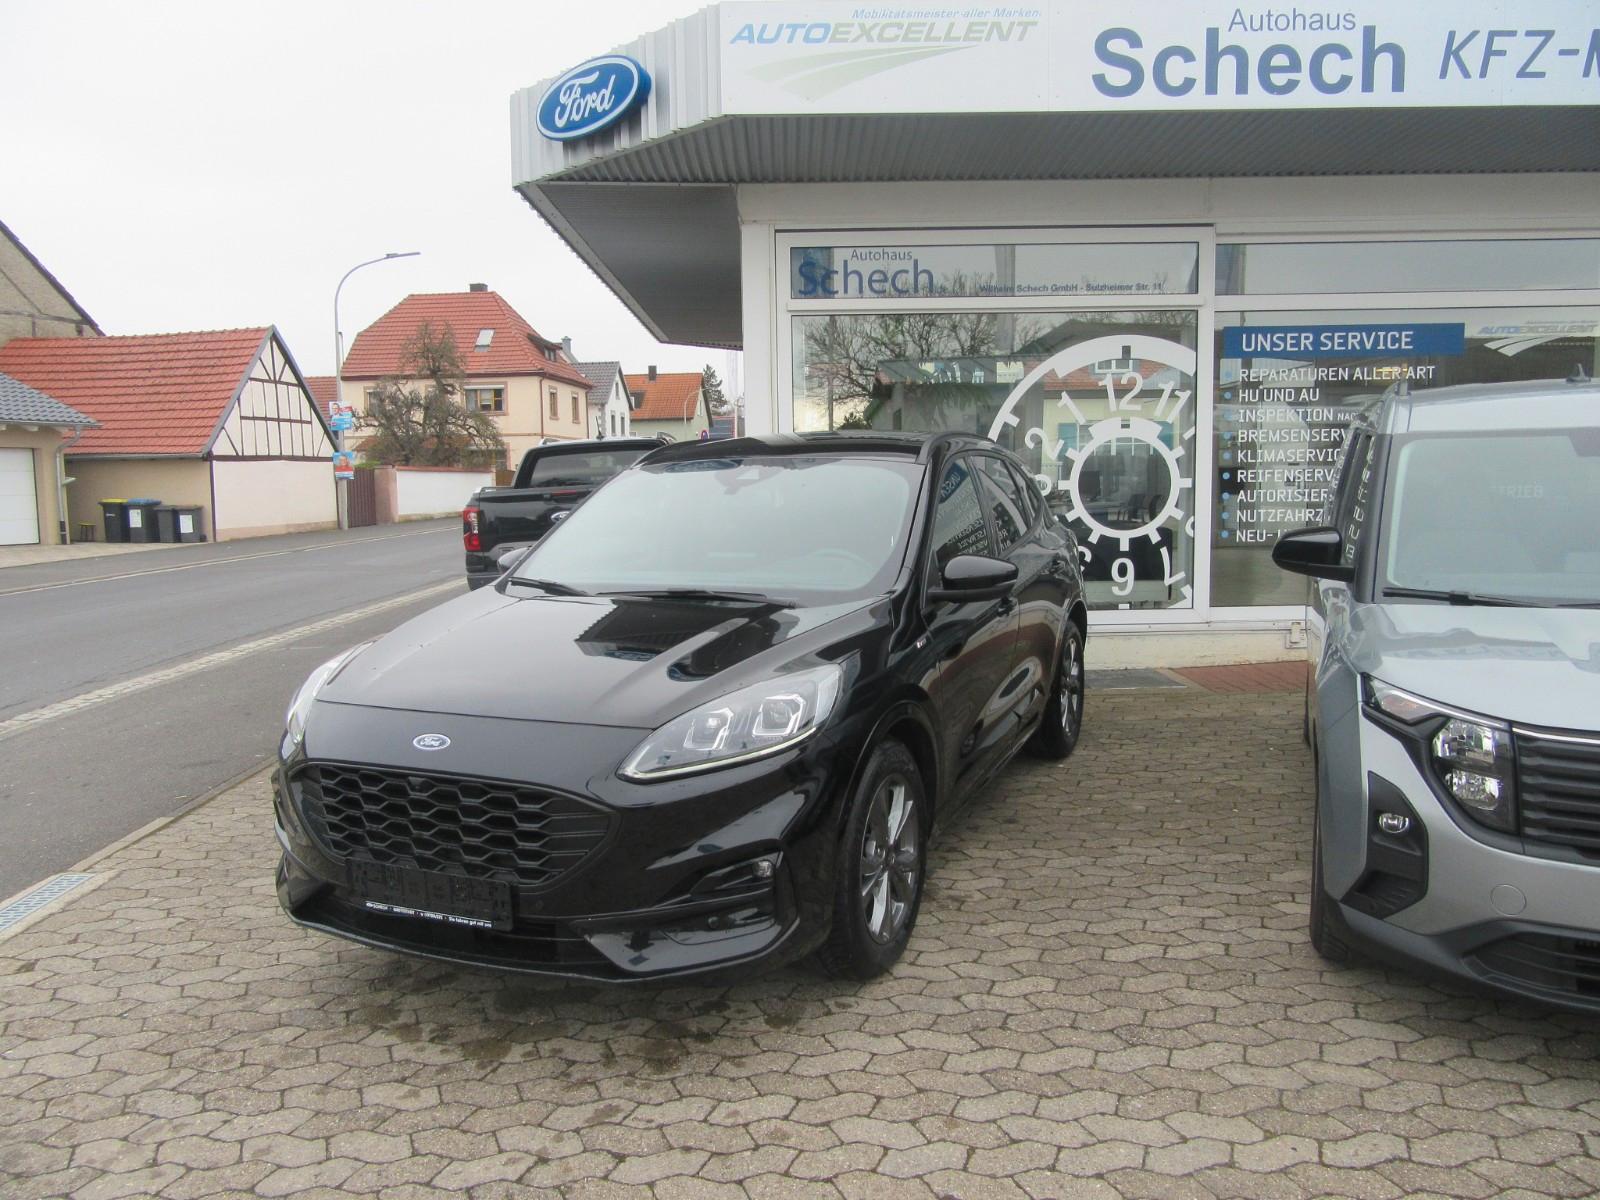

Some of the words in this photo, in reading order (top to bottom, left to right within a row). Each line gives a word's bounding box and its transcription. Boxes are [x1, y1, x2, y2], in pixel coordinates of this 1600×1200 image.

[1228, 8, 1357, 32] Autohaus
[729, 22, 1038, 45] AUTOEXCELLENT
[1091, 26, 1406, 98] Schech
[554, 71, 617, 128] Ford
[850, 249, 912, 261] Autohaus
[798, 259, 934, 295] Schech
[979, 283, 1014, 293] Wilhelm
[1016, 283, 1049, 292] Schech
[1050, 283, 1078, 292] GmbH
[1135, 282, 1150, 291] Str.
[1241, 333, 1314, 352] UNSER
[1320, 331, 1414, 350] SERVICE
[1239, 368, 1349, 382] REPARATUREN
[1353, 367, 1401, 380] ALLER
[1406, 366, 1436, 379] ART
[1098, 371, 1144, 412] 12
[1239, 388, 1259, 402] HU
[1263, 388, 1295, 402] UND
[1299, 387, 1320, 401] AU
[1238, 408, 1334, 422] INSPEKTION
[1237, 468, 1335, 483] REIFENSERV
